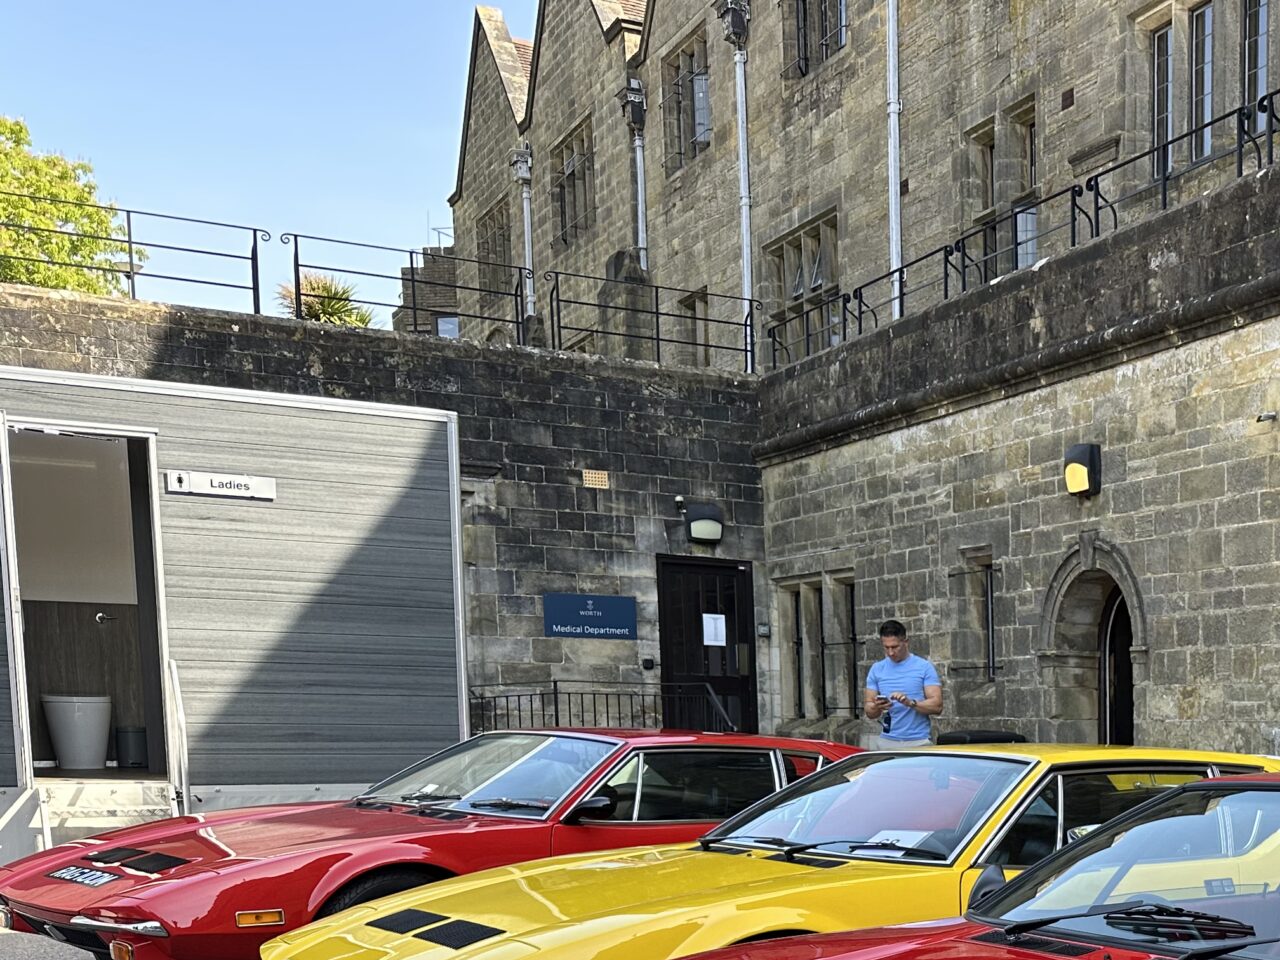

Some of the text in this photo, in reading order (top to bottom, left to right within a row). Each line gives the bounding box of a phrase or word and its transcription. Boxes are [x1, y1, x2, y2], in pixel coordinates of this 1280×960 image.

[209, 478, 251, 491] Ladies
[552, 624, 629, 635] Medical Department
